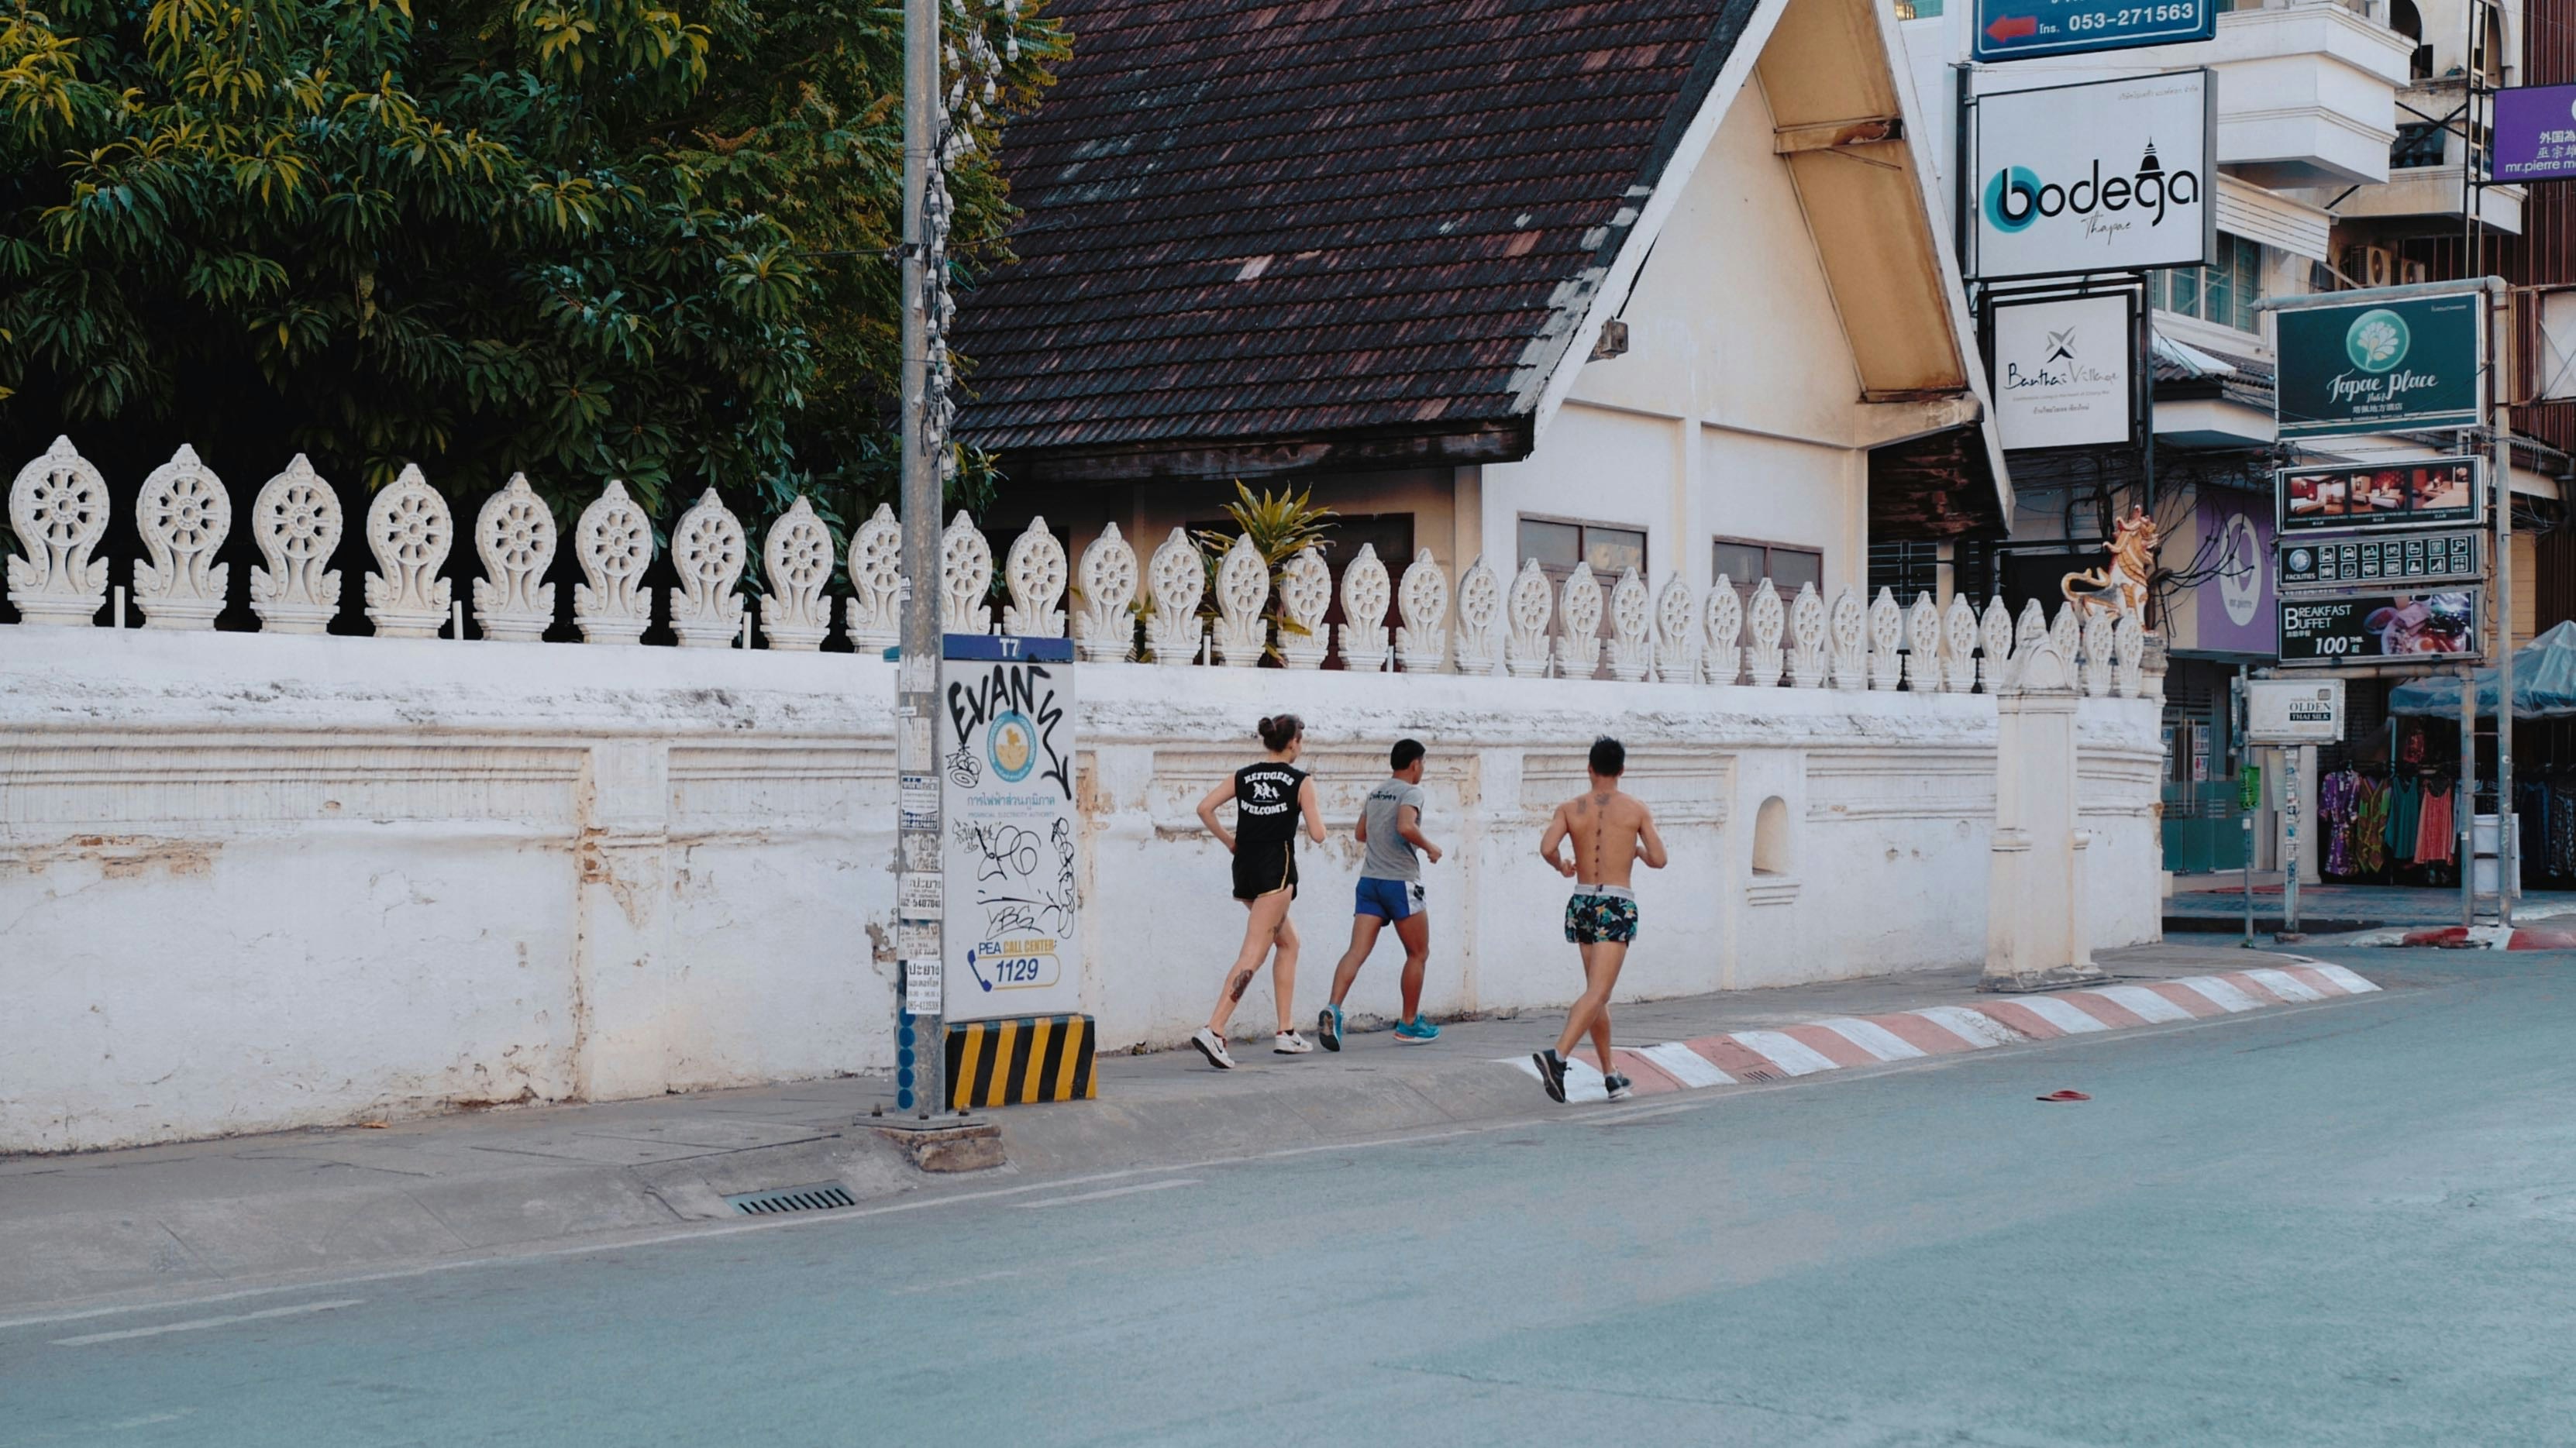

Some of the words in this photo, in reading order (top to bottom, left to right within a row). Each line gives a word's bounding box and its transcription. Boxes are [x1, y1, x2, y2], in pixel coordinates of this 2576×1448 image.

[2068, 2, 2194, 32] 053-271563
[2505, 160, 2560, 174] mr.pierre
[2001, 159, 2199, 227] bodega
[2285, 604, 2352, 630] BREAKFAST
[999, 638, 1020, 657] T7
[2316, 636, 2347, 655] 100
[2289, 702, 2331, 712] OLDEN
[1244, 772, 1295, 786] REFUGEES
[1241, 800, 1287, 815] WELCOME
[979, 942, 1001, 954] PEA
[1004, 940, 1023, 954] CALL
[1025, 939, 1055, 953] CENTER
[997, 958, 1038, 982] 1129
